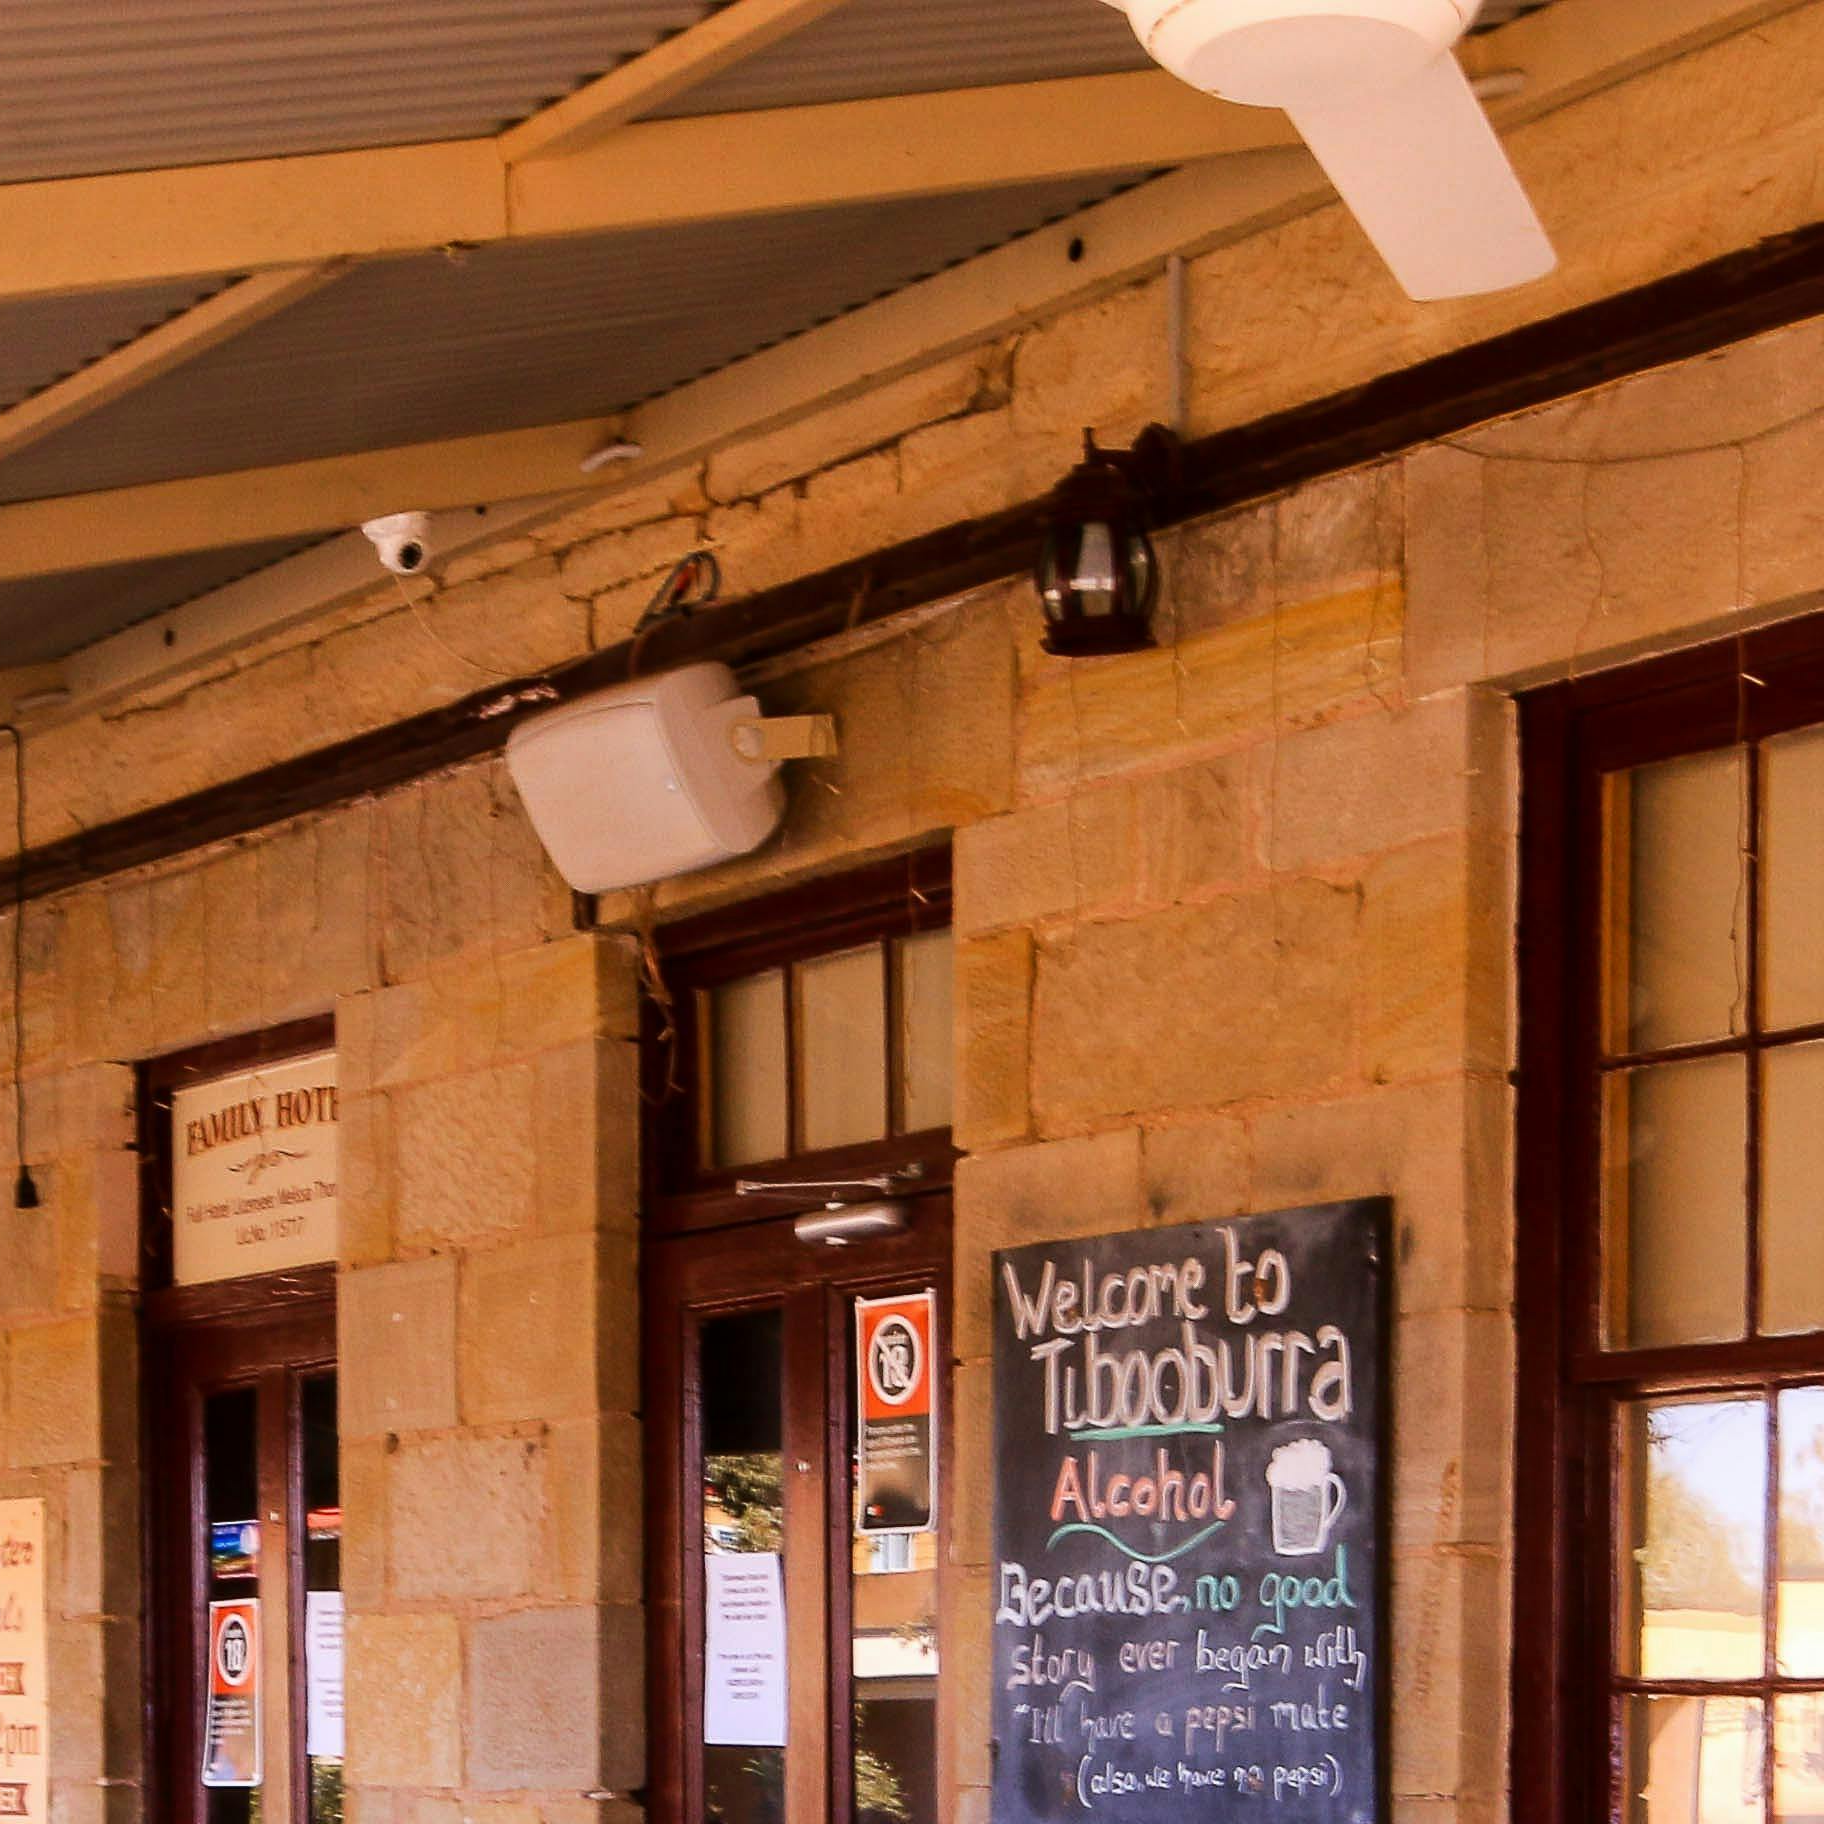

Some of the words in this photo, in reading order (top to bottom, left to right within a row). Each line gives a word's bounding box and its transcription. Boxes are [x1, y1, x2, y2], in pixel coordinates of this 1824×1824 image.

[186, 1096, 263, 1157] FAMILY
[1002, 1256, 1209, 1340] Welcome
[1216, 1225, 1290, 1325] to
[1030, 1319, 1353, 1434] Tibooburra
[1050, 1440, 1236, 1523] Alcohol
[1196, 1573, 1241, 1612] no
[1251, 1543, 1357, 1642] good
[1006, 1632, 1095, 1703] story
[1119, 1639, 1180, 1674] ever
[1195, 1628, 1292, 1693] began
[1304, 1625, 1367, 1692] with
[1080, 1701, 1137, 1753] have
[1155, 1711, 1174, 1737] a
[1185, 1703, 1256, 1756] pepsi
[1270, 1683, 1349, 1731] mate
[1178, 1761, 1226, 1795] have
